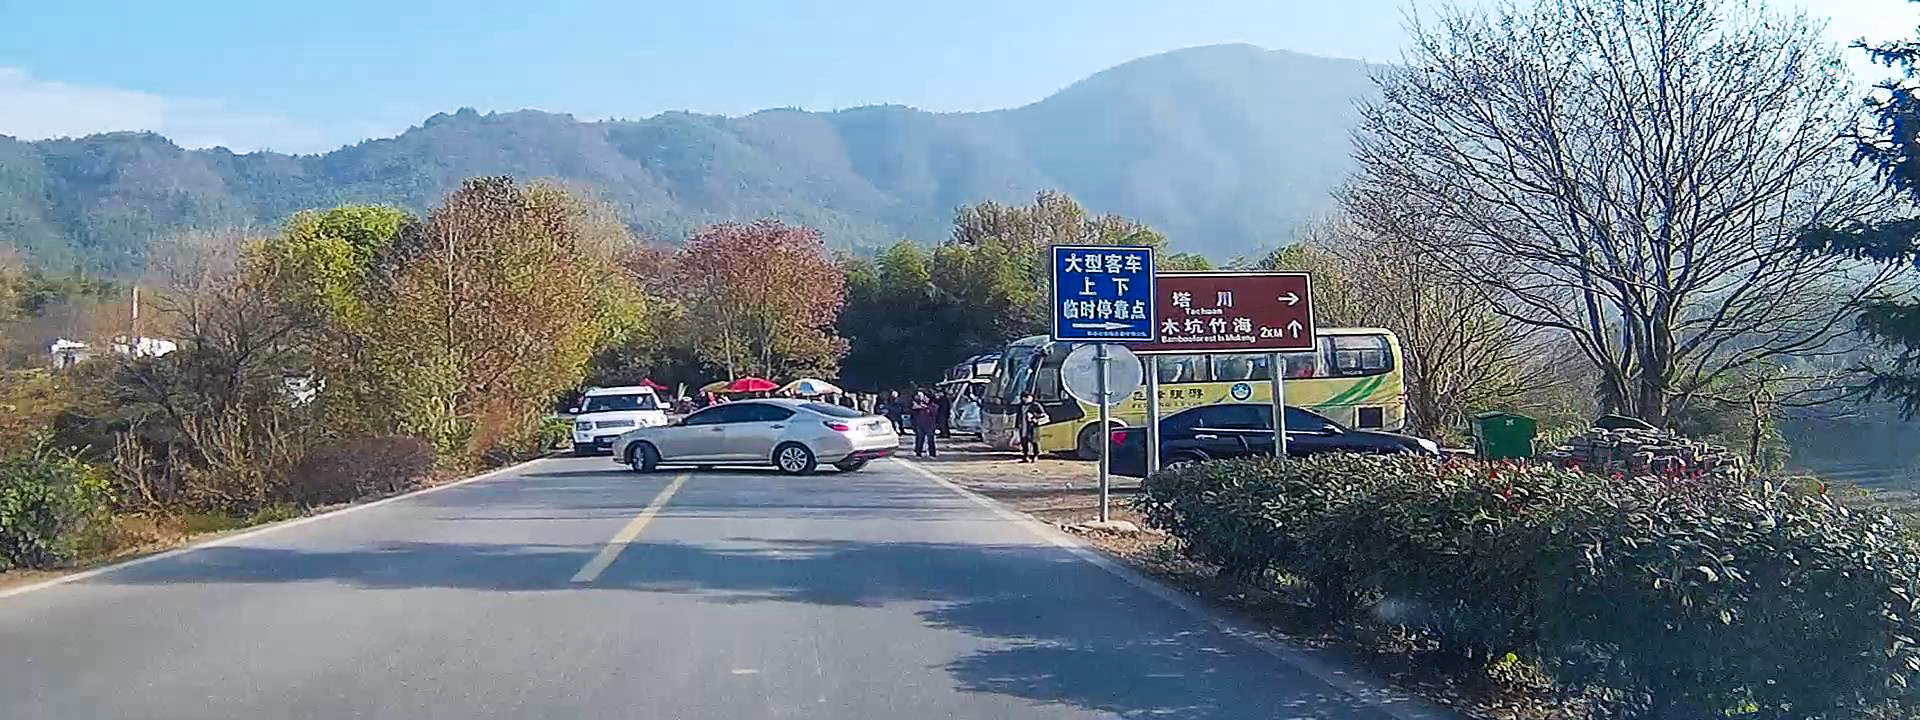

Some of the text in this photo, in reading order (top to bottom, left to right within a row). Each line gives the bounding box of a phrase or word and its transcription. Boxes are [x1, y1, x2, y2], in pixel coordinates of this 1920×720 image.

[1064, 253, 1143, 274] 大型客车
[1063, 299, 1146, 319] 临时停靠点
[1161, 317, 1252, 335] 木坑竹海
[1260, 326, 1283, 338] 2KM
